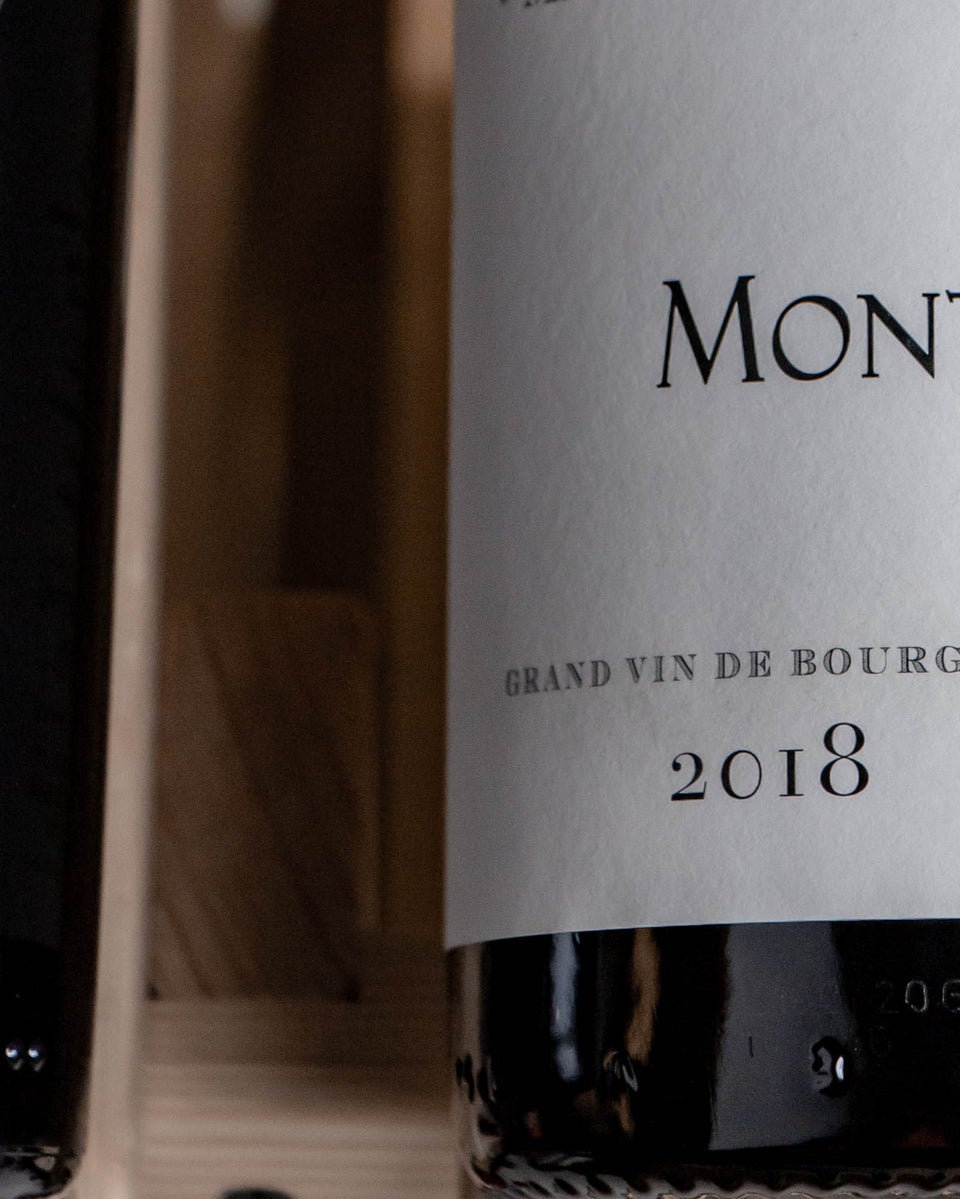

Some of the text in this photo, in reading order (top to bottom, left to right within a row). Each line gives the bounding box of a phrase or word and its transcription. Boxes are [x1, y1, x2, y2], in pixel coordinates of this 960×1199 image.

[505, 658, 612, 698] GRAND
[626, 653, 698, 684] VIN
[715, 649, 773, 680] DE
[670, 721, 870, 802] 2018
